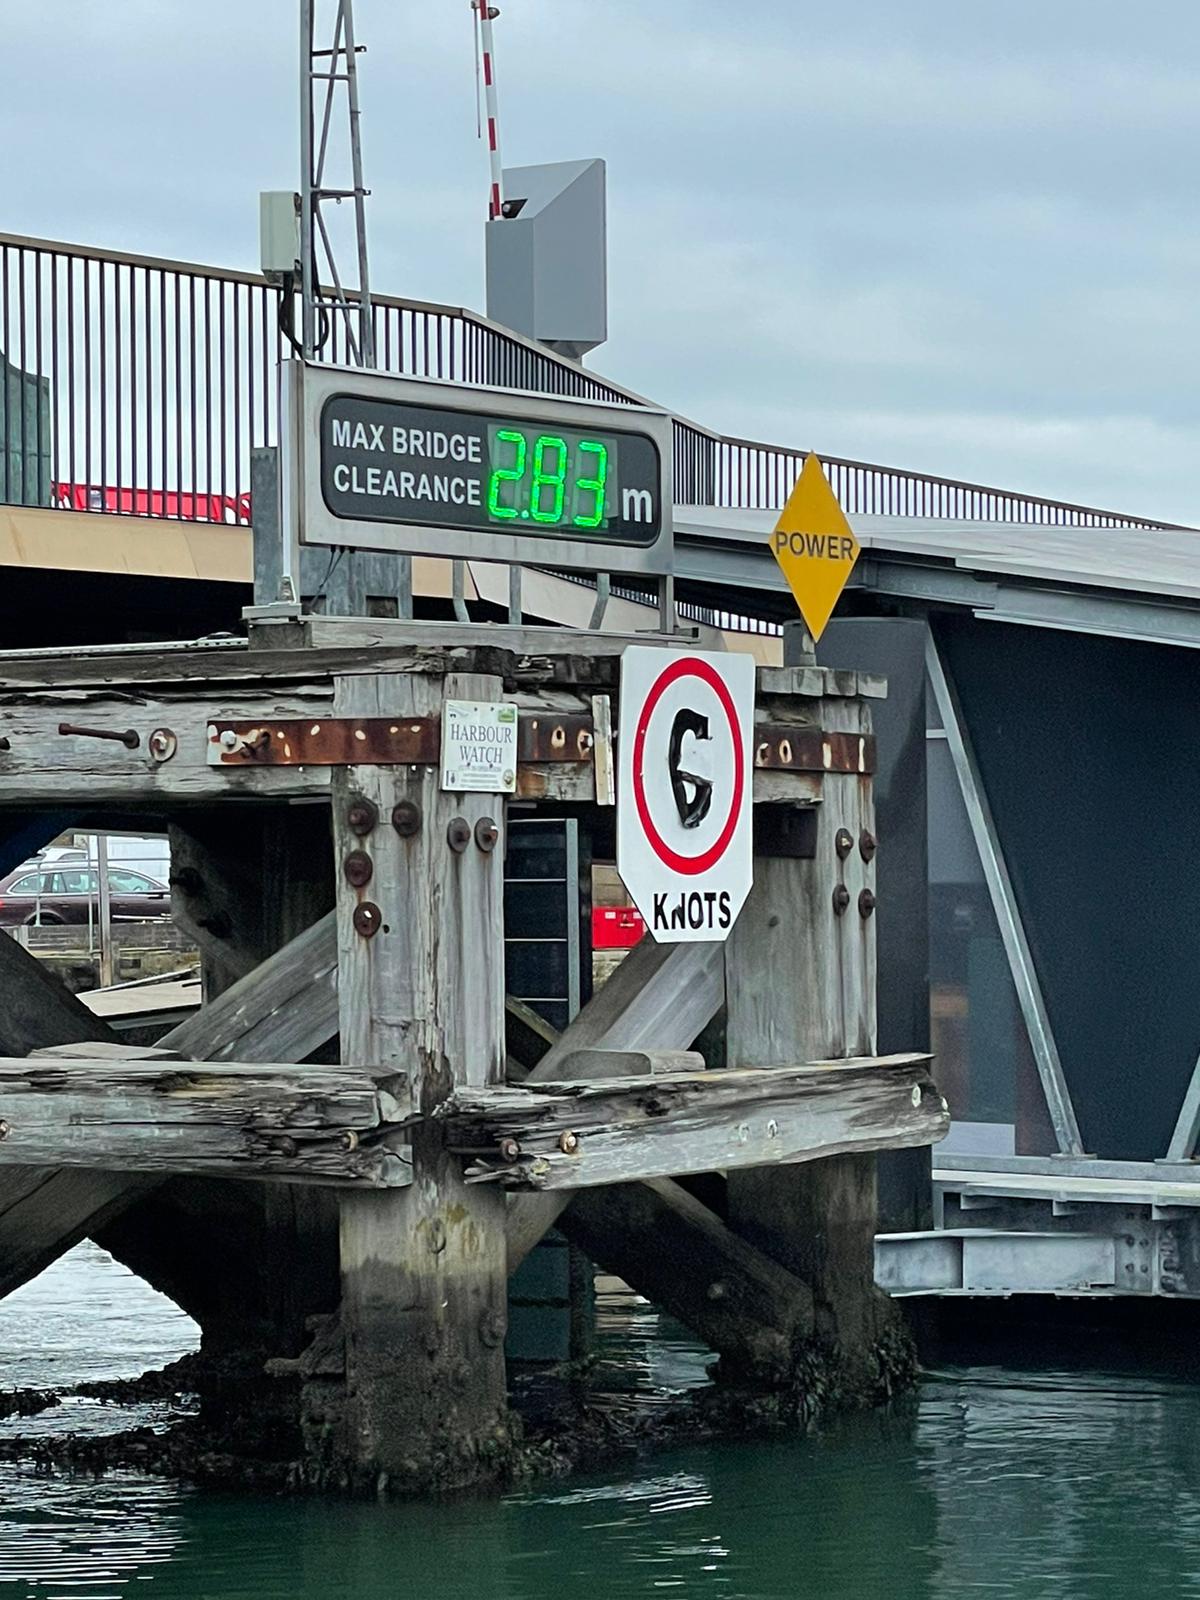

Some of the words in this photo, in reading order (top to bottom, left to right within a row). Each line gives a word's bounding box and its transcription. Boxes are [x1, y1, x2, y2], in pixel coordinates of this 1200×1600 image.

[332, 419, 385, 452] MAX
[392, 426, 481, 463] BRIDGE
[333, 465, 481, 506] CLEARANCE
[488, 430, 608, 528] 2.83
[622, 487, 653, 523] m
[775, 531, 854, 561] POWER
[450, 724, 512, 743] HARBOUR
[460, 745, 503, 764] WATCH
[653, 891, 731, 930] KNOTS
